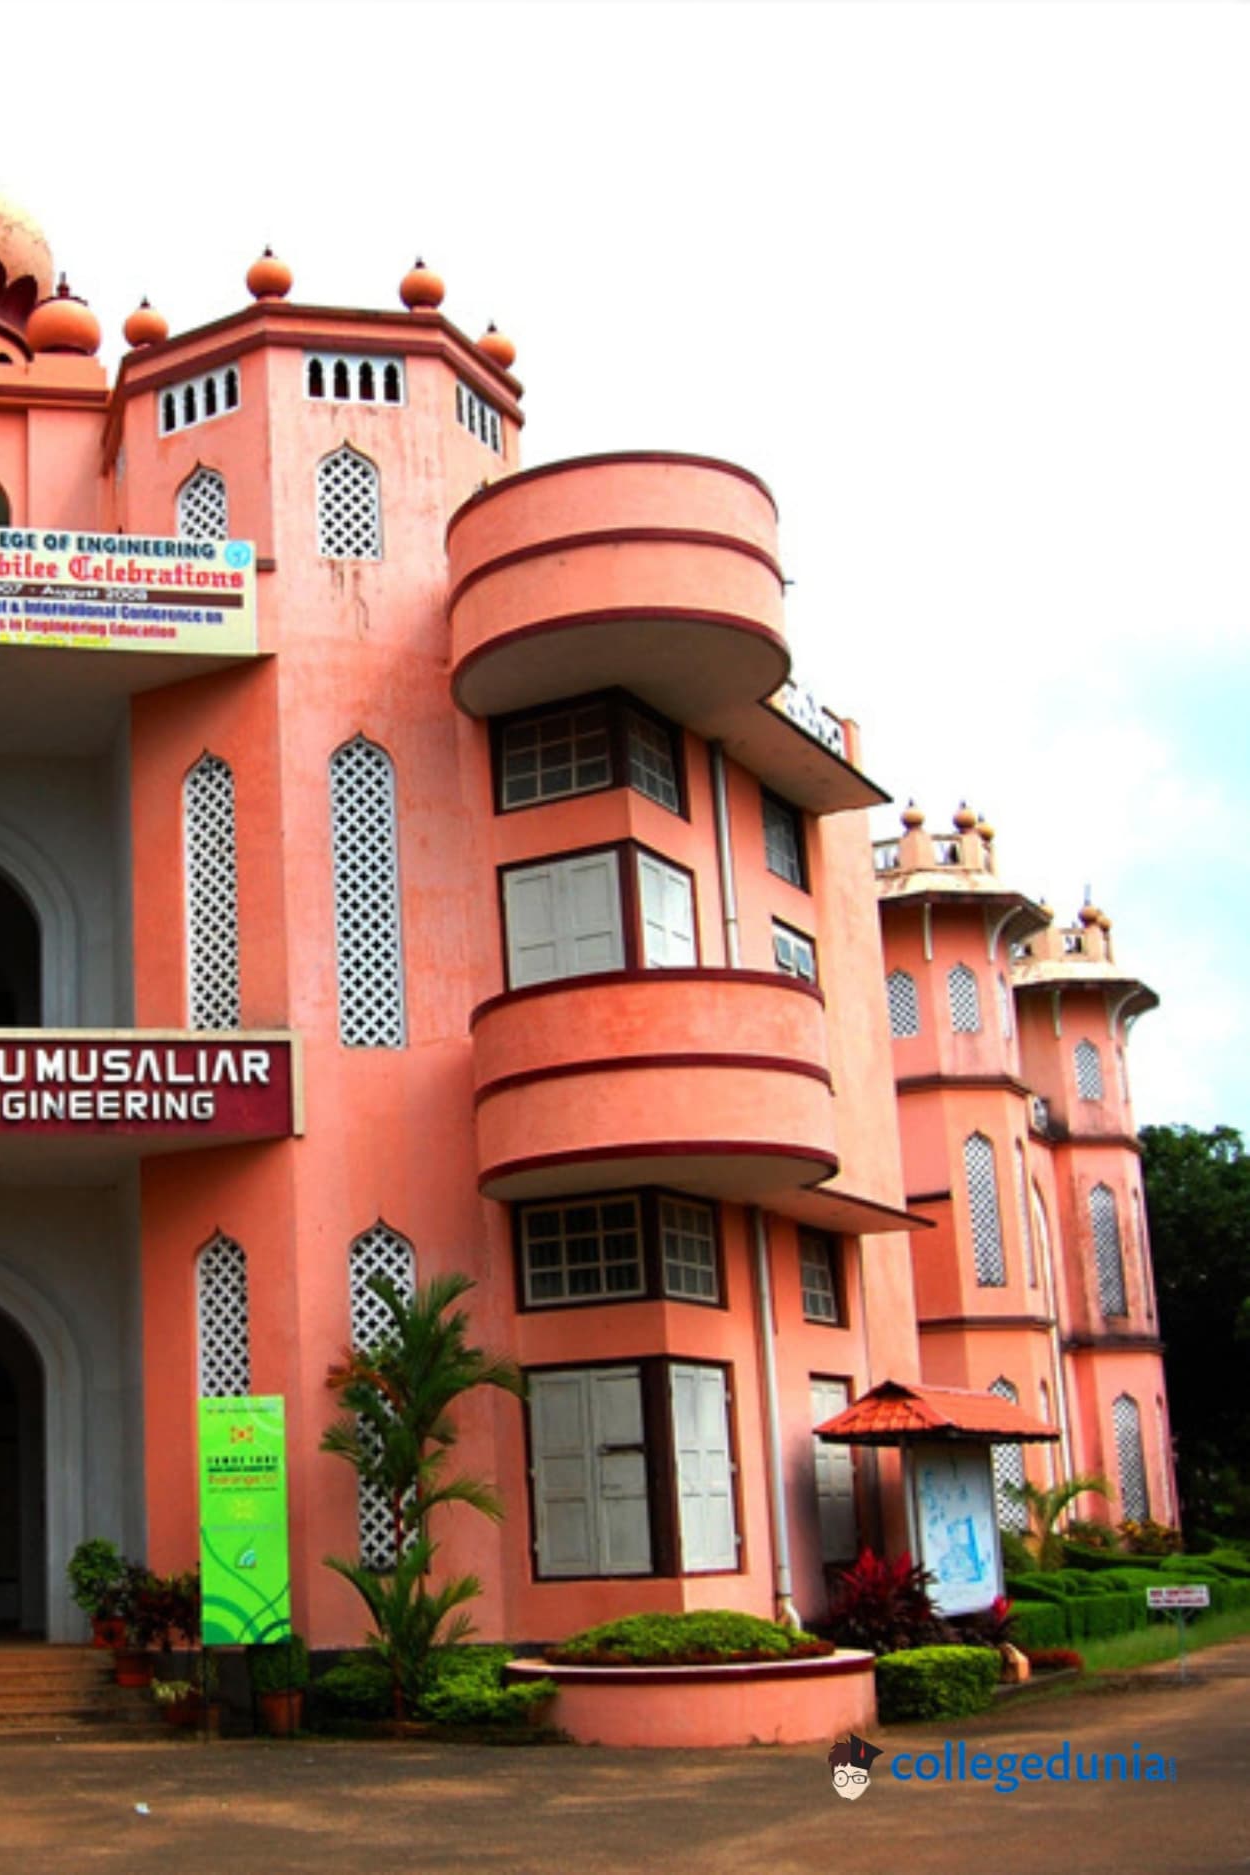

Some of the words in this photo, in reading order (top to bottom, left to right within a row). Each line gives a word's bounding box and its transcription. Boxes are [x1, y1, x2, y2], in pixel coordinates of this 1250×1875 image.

[43, 534, 69, 551] OF
[77, 536, 216, 559] ENGINEERING
[69, 555, 244, 588] Celebrations
[36, 1048, 271, 1084] MUSALIAR
